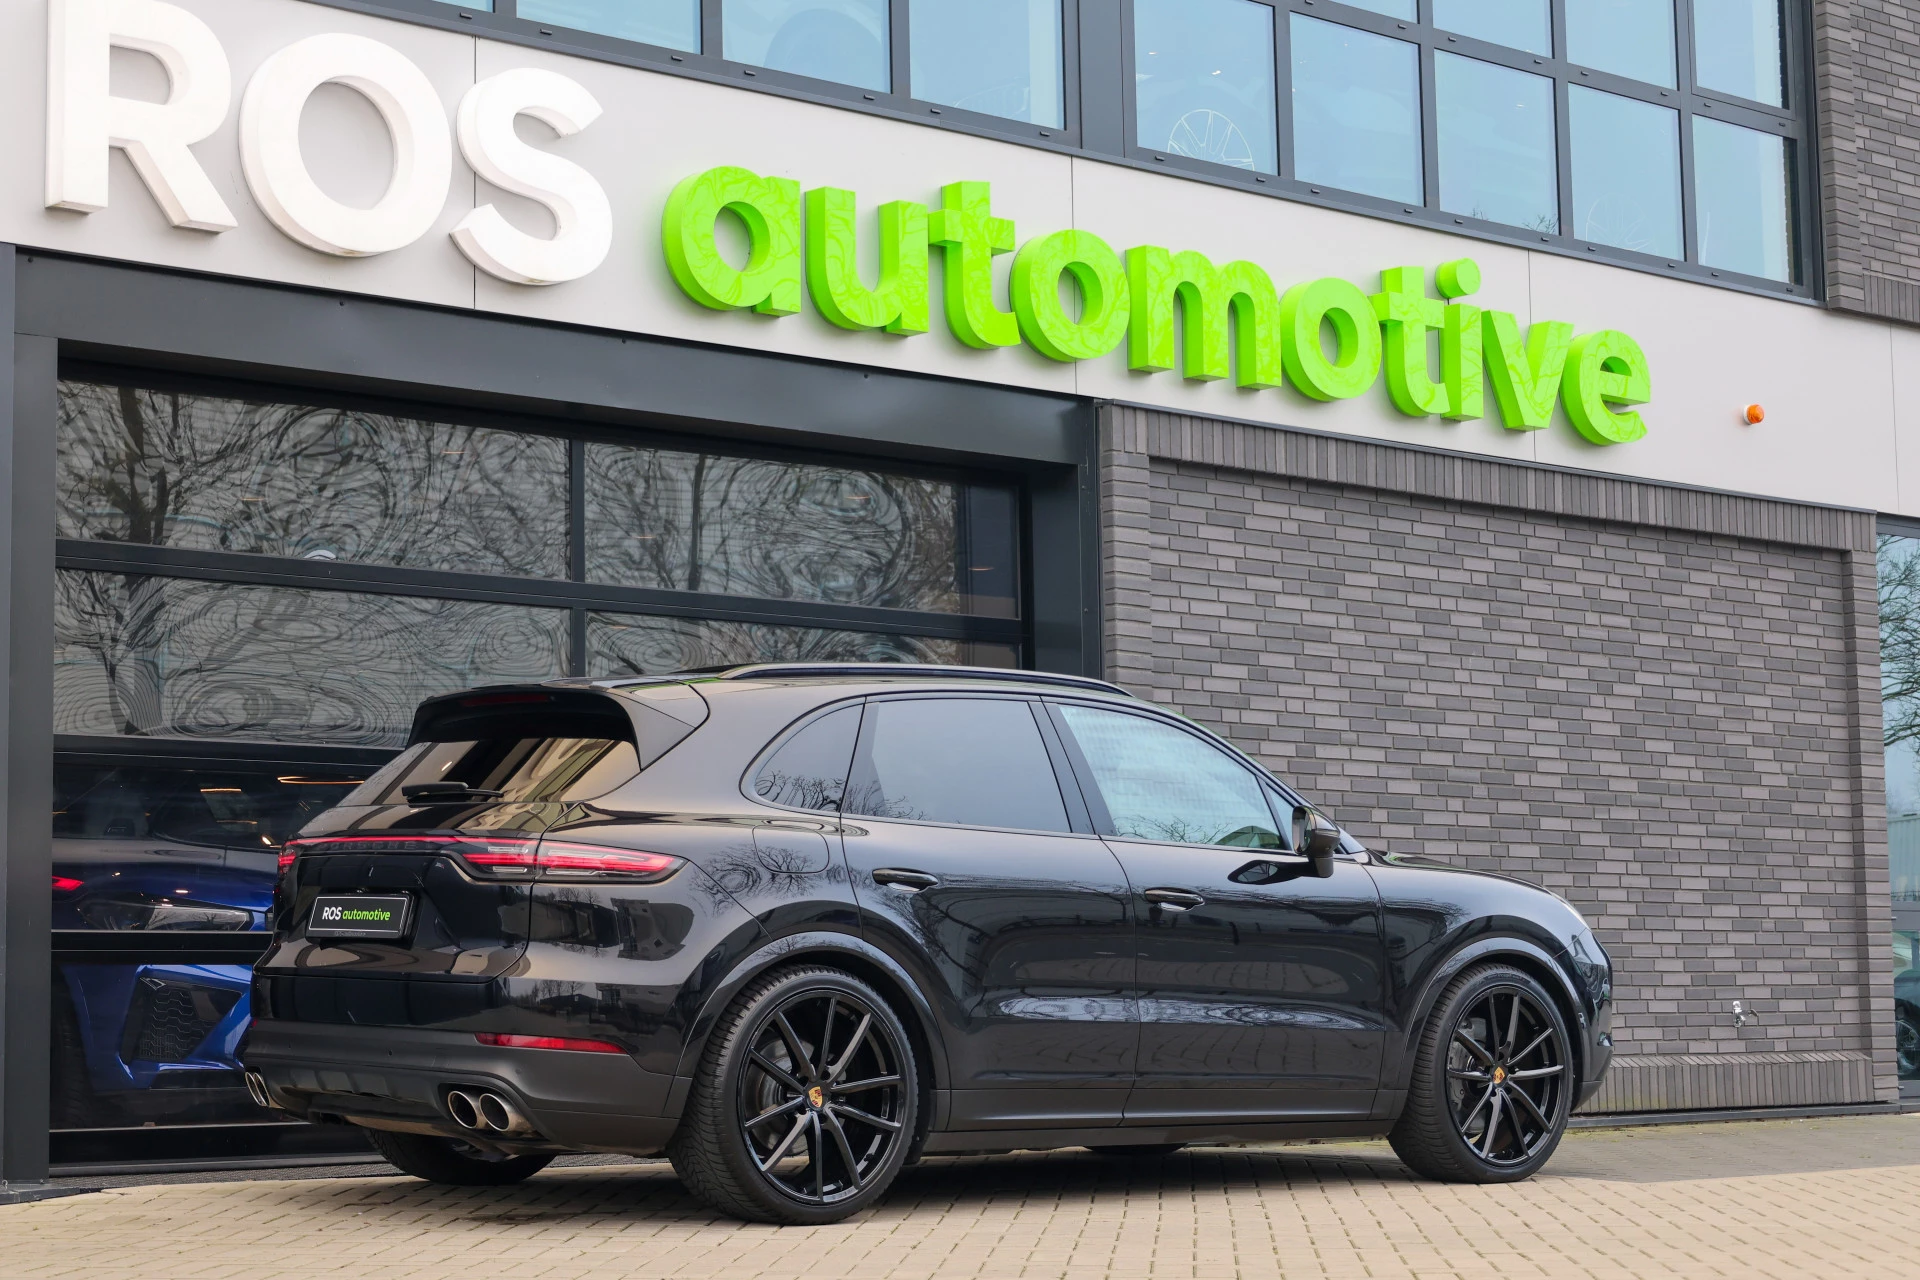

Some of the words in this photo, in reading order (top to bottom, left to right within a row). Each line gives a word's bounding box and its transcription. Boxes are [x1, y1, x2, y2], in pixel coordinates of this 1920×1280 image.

[45, 0, 613, 286] ROS
[661, 165, 1651, 446] automotive
[322, 907, 342, 920] ROS
[342, 909, 390, 920] automotive
